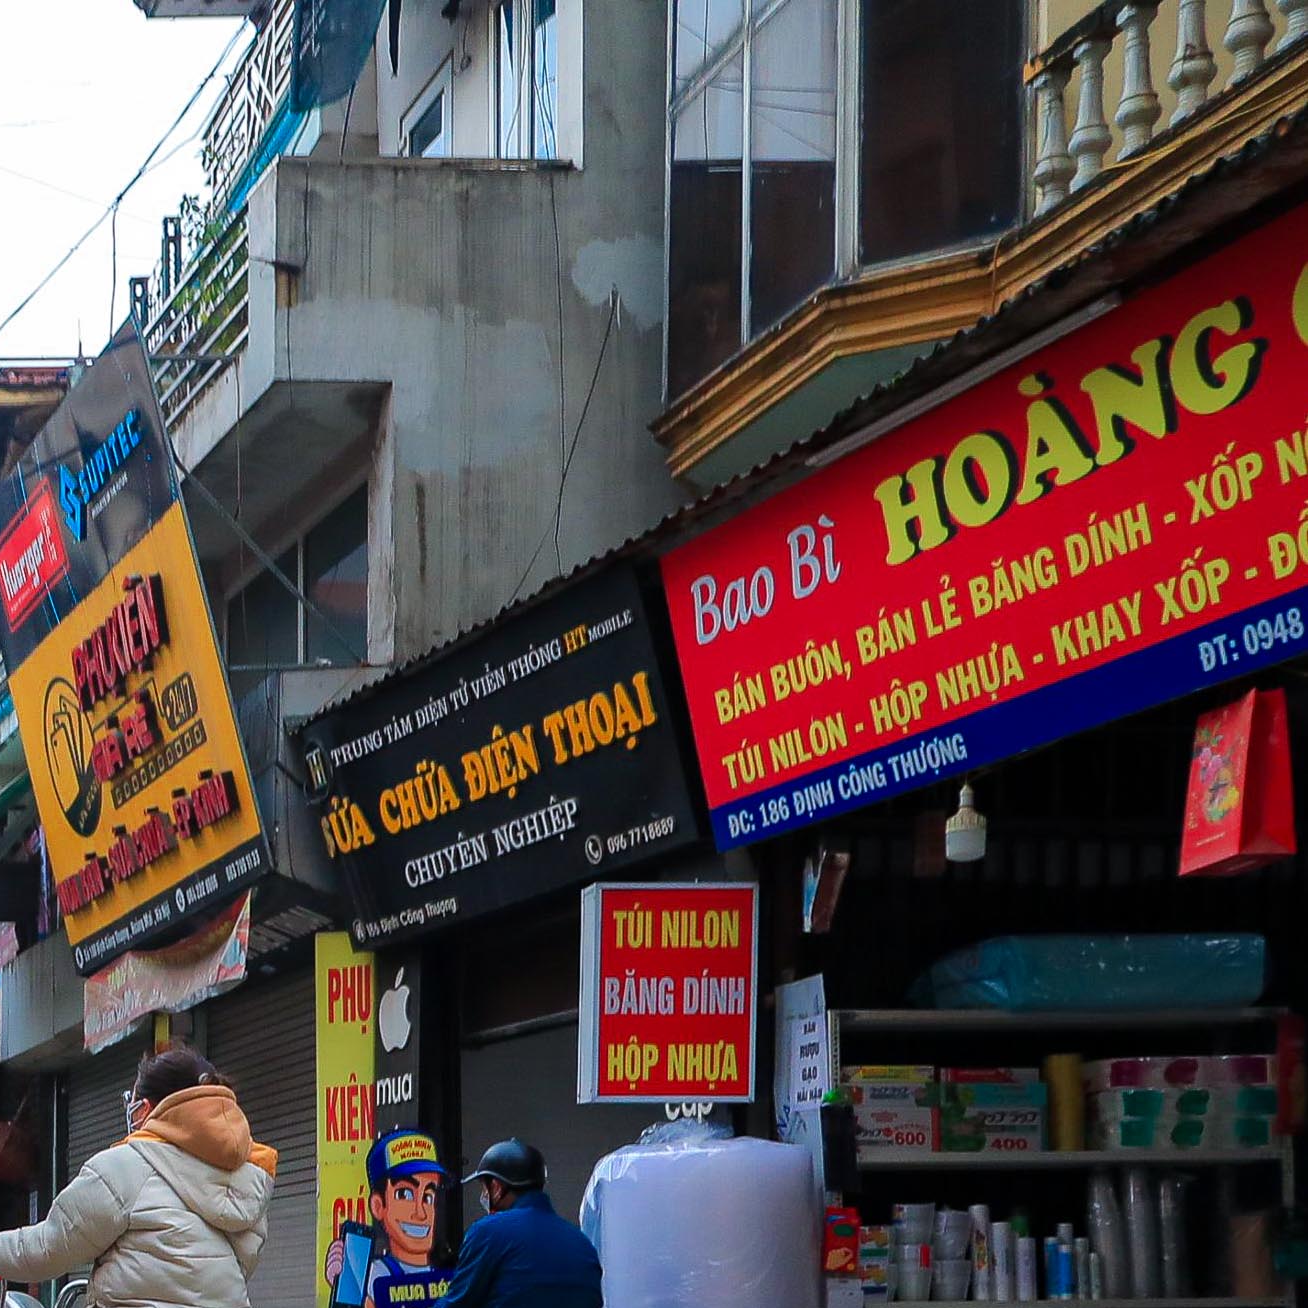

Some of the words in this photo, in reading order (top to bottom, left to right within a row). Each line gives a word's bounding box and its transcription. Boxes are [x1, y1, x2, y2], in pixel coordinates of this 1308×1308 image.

[78, 414, 140, 504] SUPITEC
[690, 556, 774, 646] Bao
[787, 514, 841, 602] Bì
[872, 298, 1256, 568] HOÀNG
[714, 667, 766, 726] BÁN
[771, 633, 854, 700] BUÔN,
[857, 606, 915, 667] BÁN
[923, 578, 961, 647] LẺ
[969, 545, 1058, 616] BĂNG
[1069, 503, 1151, 576] DÍNH
[1185, 440, 1263, 525] XỐP
[330, 731, 383, 769] TRUNG
[415, 702, 450, 736] ĐIỆN
[450, 676, 471, 710] TỬ
[470, 662, 507, 699] VIỄN
[507, 643, 562, 682] THÔNG
[563, 623, 589, 655] HT
[588, 609, 634, 642] MOBILE
[723, 740, 765, 789] TÚI
[770, 710, 848, 772] NILON
[870, 680, 929, 738] HỘP
[935, 643, 1025, 712] NHỰA
[1051, 595, 1142, 667] KHAY
[1152, 548, 1230, 625] XỐP
[379, 755, 461, 832] CHỮA
[463, 724, 541, 800] ĐIỆN
[543, 670, 658, 765] THOẠI
[728, 811, 756, 840] ĐC:
[758, 798, 790, 829] 186
[793, 780, 836, 820] ĐỊNH
[840, 757, 888, 802] CÔNG
[888, 733, 969, 788] THƯỢNG
[1198, 634, 1240, 674] ĐT:
[1243, 607, 1306, 657] 0948
[404, 831, 490, 890] CHUYÊN
[494, 794, 580, 856] NGHIỆP
[606, 832, 627, 855] 096
[628, 815, 674, 847] 7718889
[399, 907, 425, 926] Công
[613, 903, 653, 950] TÚI
[660, 908, 740, 950] NILON
[327, 964, 372, 1035] PHỤ
[604, 969, 675, 1016] BĂNG
[682, 968, 745, 1016] DÍNH
[376, 1073, 412, 1107] mua
[606, 1037, 660, 1090] HỘP
[667, 1040, 739, 1090] NHỰA
[326, 1072, 375, 1154] KIỆN
[895, 1131, 926, 1146] 600
[991, 1137, 1029, 1151] 400
[389, 1284, 425, 1302] MUA
